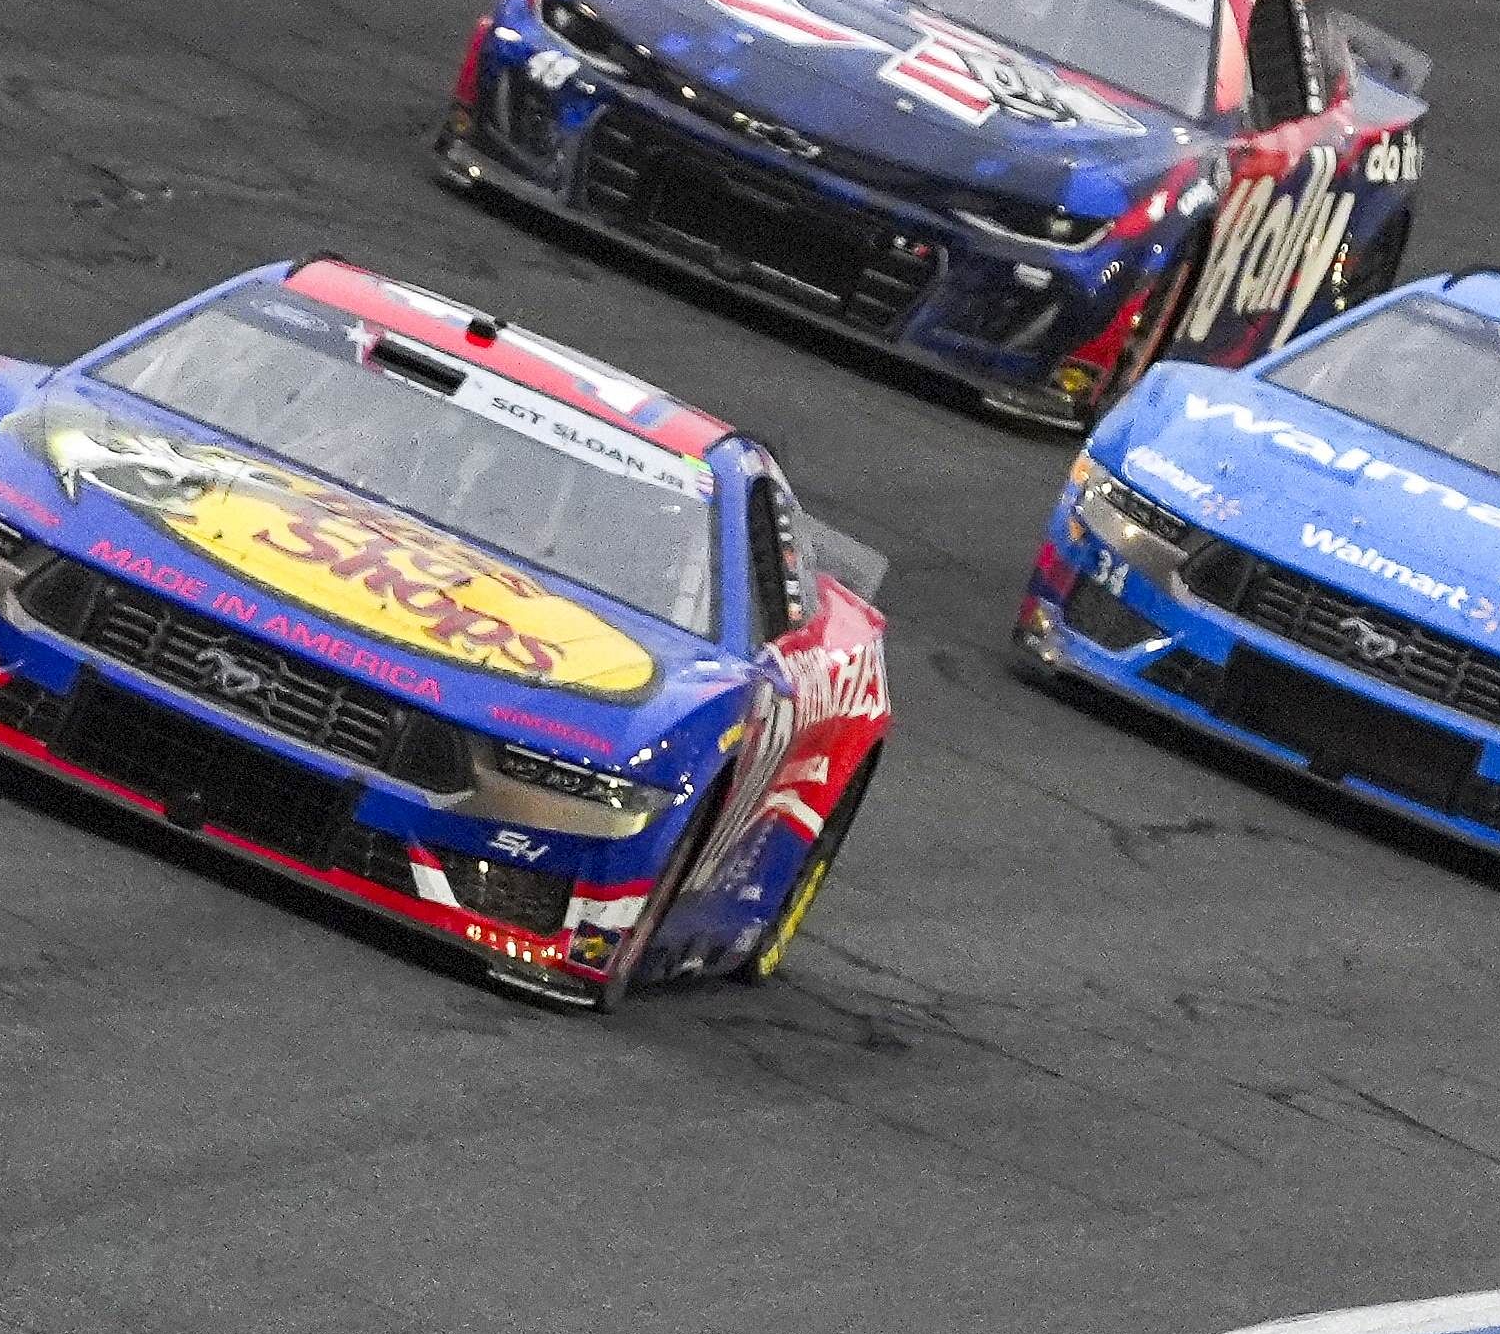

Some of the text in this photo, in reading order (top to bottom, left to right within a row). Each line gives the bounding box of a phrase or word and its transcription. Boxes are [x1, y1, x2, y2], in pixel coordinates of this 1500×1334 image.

[491, 396, 546, 425] SGT
[552, 421, 646, 473] SLOAN
[89, 539, 443, 703] MADE IN AMERICA
[251, 503, 567, 673] Shops
[1300, 522, 1468, 610] Walmart
